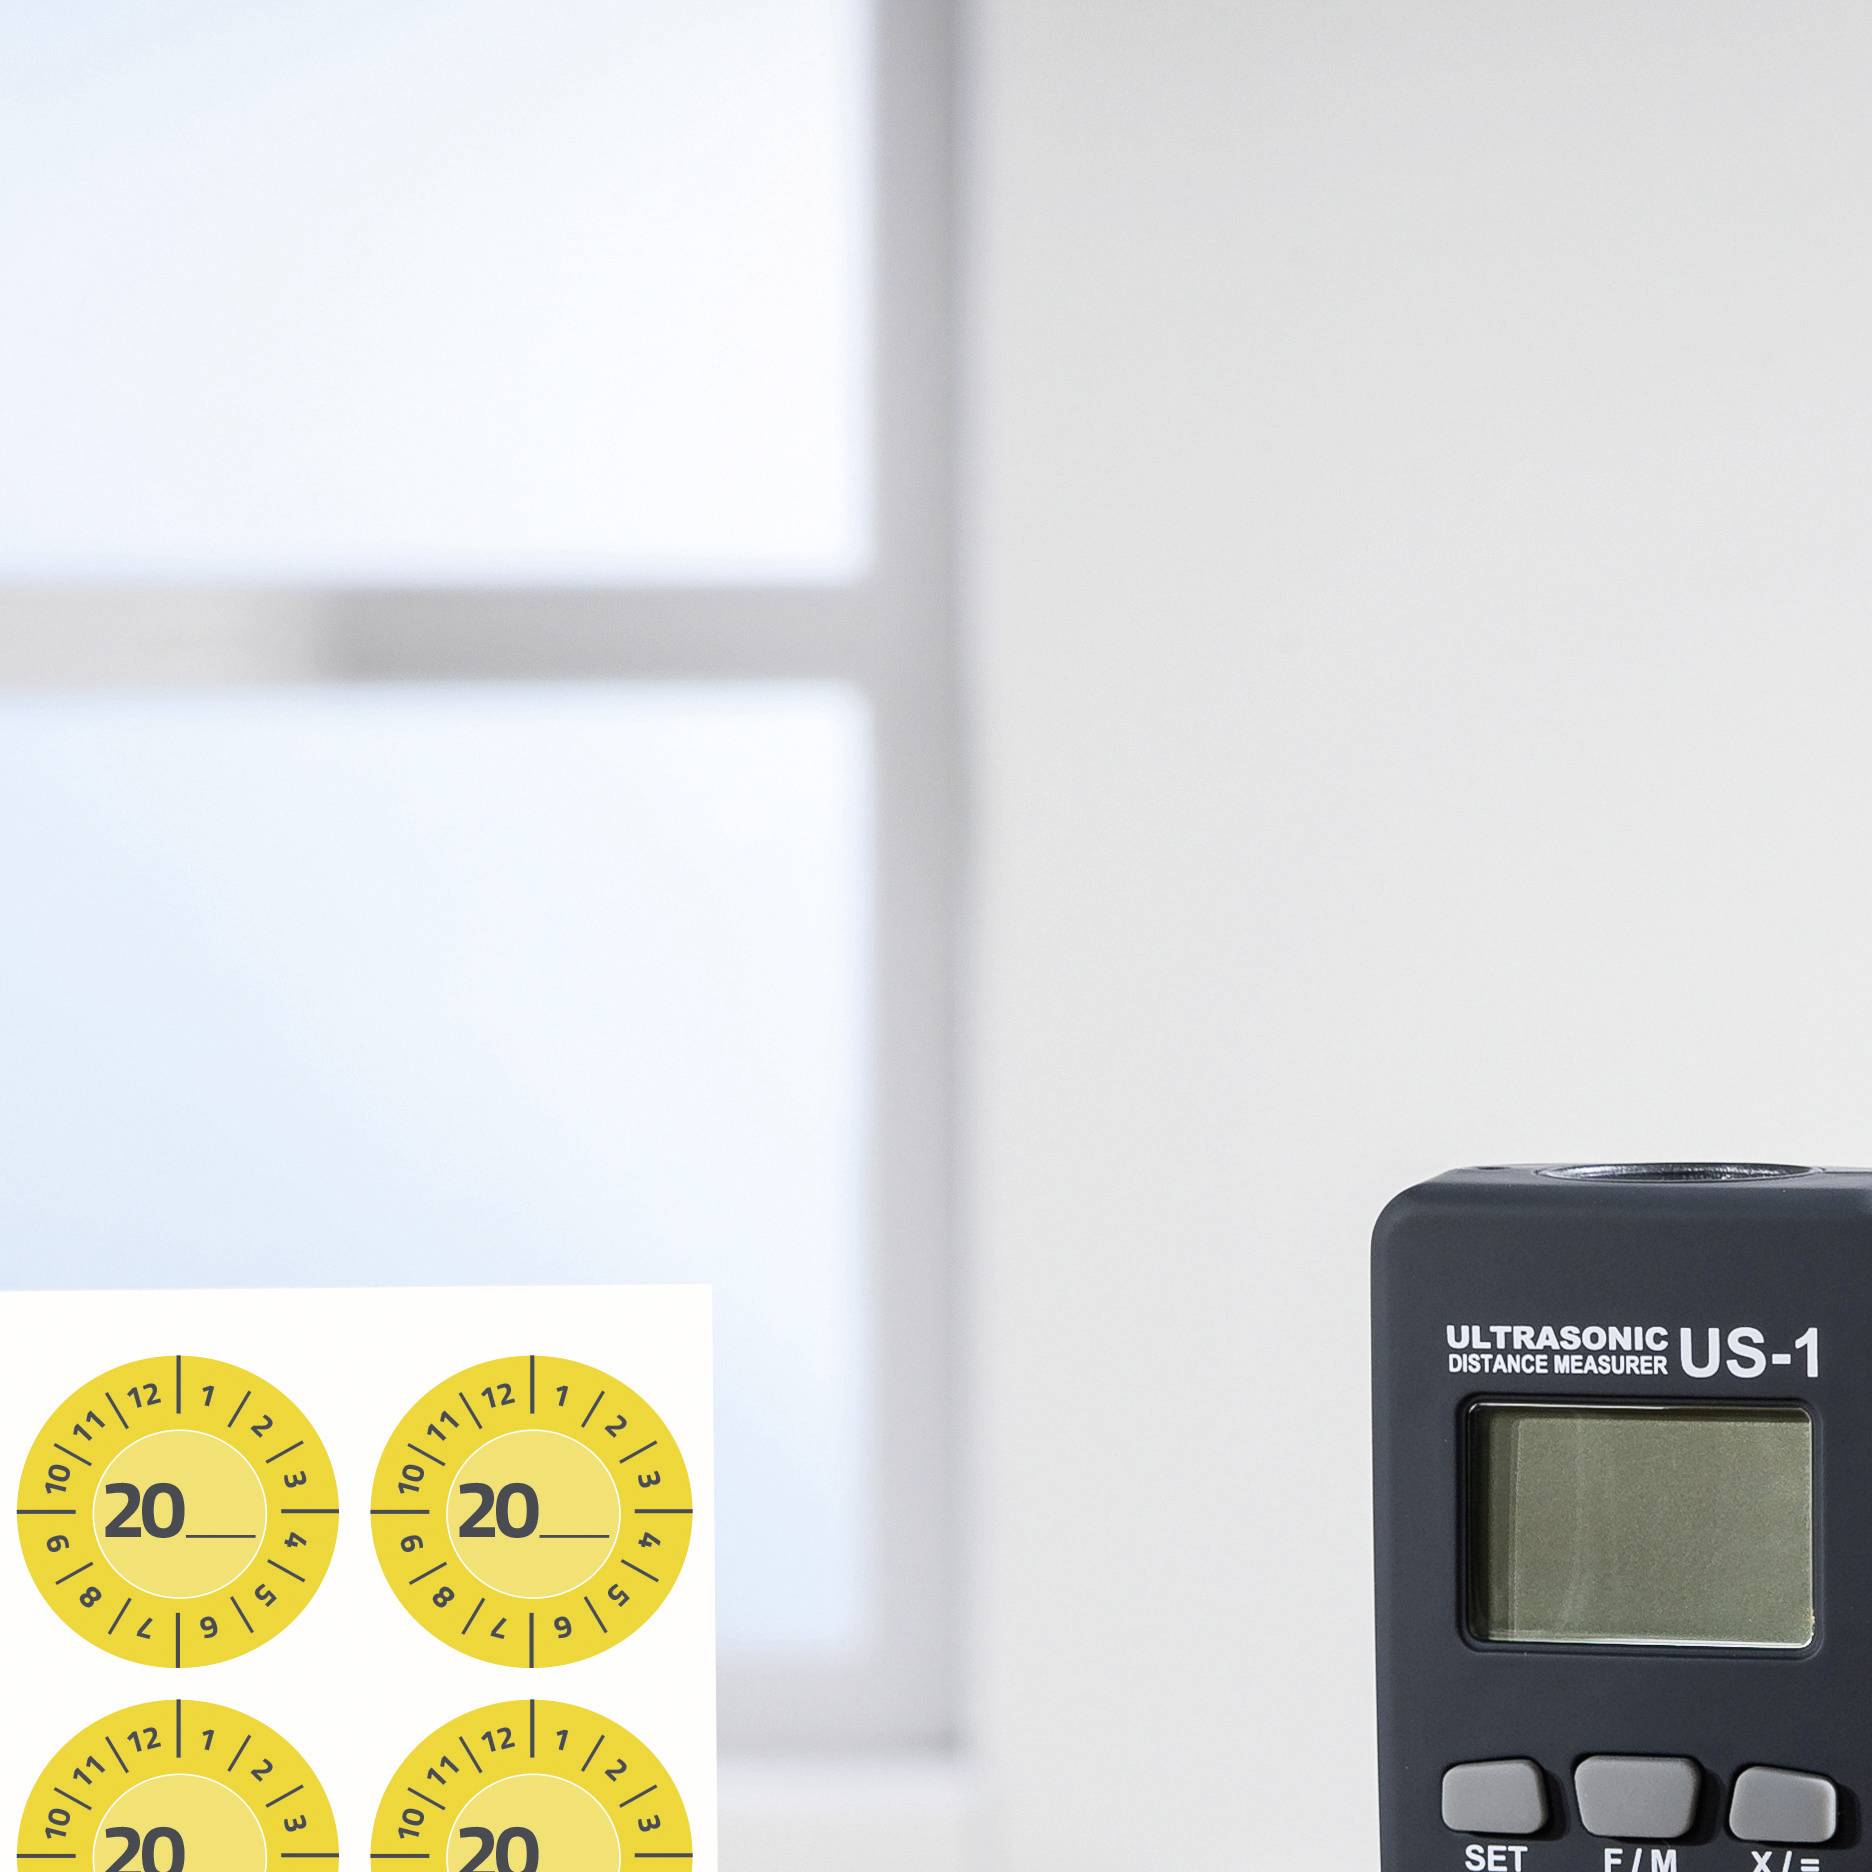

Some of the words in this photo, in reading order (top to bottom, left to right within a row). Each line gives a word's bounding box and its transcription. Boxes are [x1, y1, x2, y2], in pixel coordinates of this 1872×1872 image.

[1445, 1323, 1669, 1352] ULTRASONIC
[1447, 1352, 1549, 1375] DISTANCE
[1553, 1353, 1669, 1376] MEASURER
[1679, 1325, 1820, 1379] US-1
[127, 1383, 162, 1408] 12
[202, 1385, 215, 1407] 1
[73, 1410, 106, 1441] 11
[250, 1414, 273, 1438] 2
[45, 1464, 71, 1494] 10
[283, 1470, 307, 1488] 3
[46, 1535, 70, 1553] 9
[284, 1532, 307, 1548] 4
[79, 1586, 102, 1608] 8
[254, 1583, 277, 1608] 5
[136, 1617, 153, 1640] 7
[199, 1616, 218, 1639] 6
